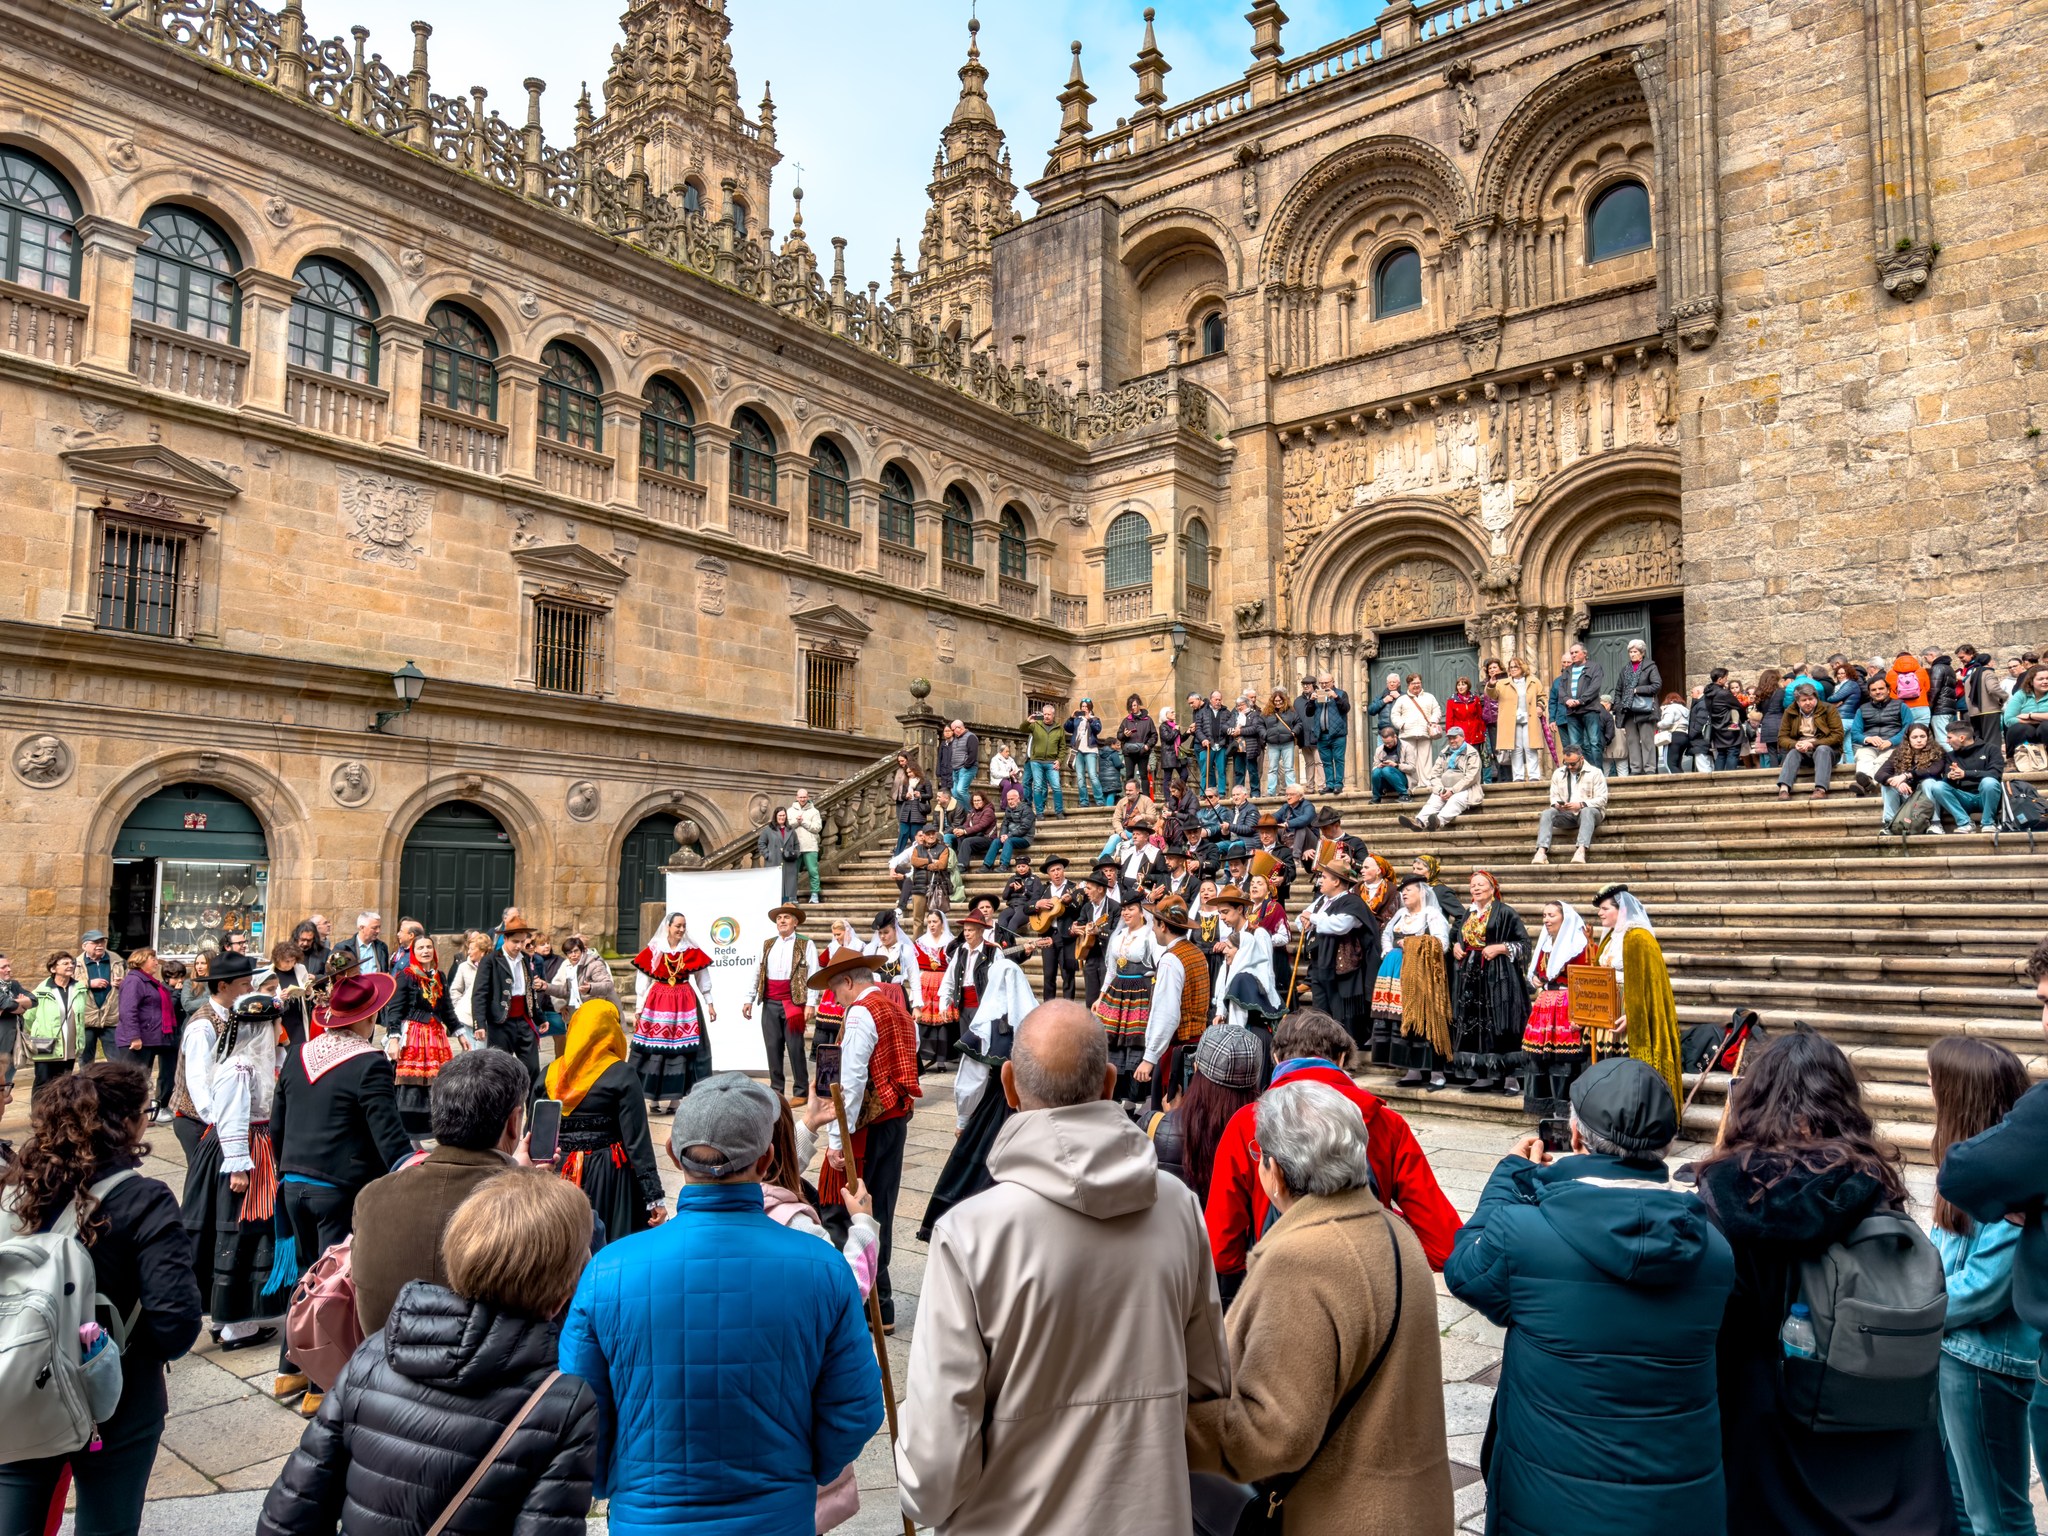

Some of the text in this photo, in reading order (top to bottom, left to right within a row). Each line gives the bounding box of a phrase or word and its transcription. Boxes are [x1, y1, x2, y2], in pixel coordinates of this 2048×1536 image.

[139, 841, 146, 852] 6
[714, 946, 737, 955] Rede
[710, 955, 756, 967] usofoni
